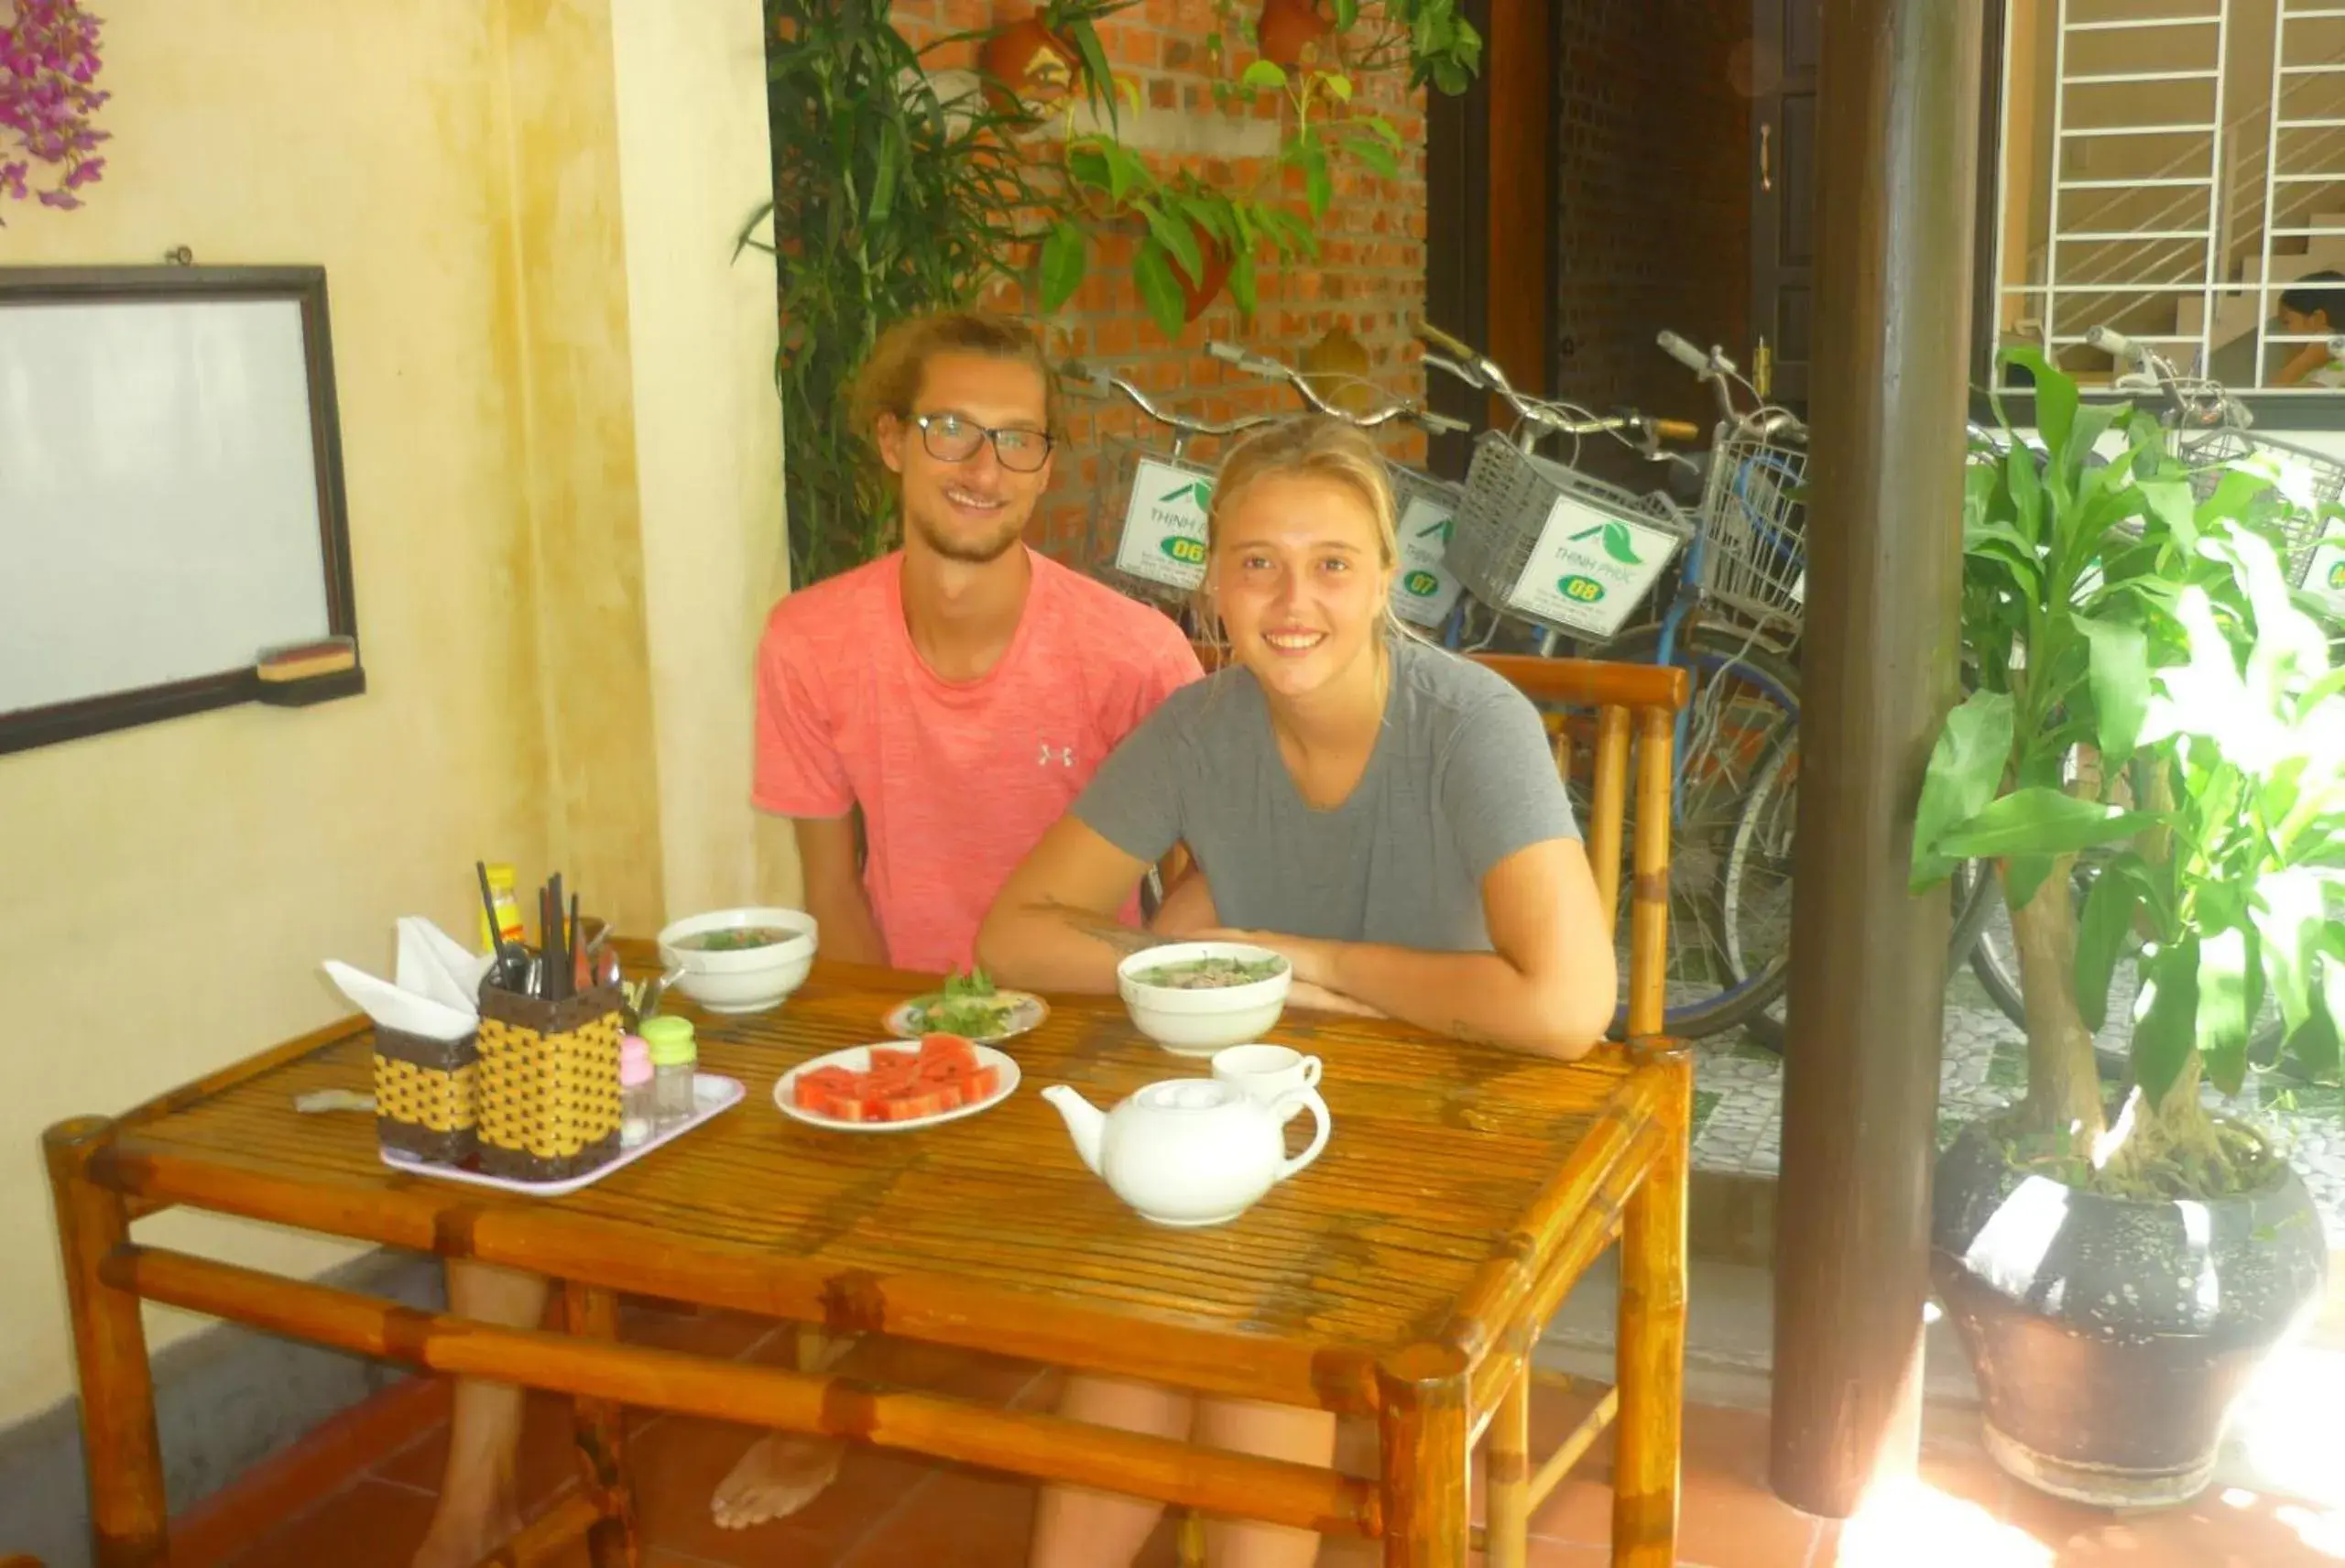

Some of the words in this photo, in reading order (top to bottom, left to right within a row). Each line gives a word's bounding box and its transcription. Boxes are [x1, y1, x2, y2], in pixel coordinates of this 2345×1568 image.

[1172, 539, 1204, 561] 06
[1411, 572, 1434, 594] 07
[1566, 578, 1598, 601] 08
